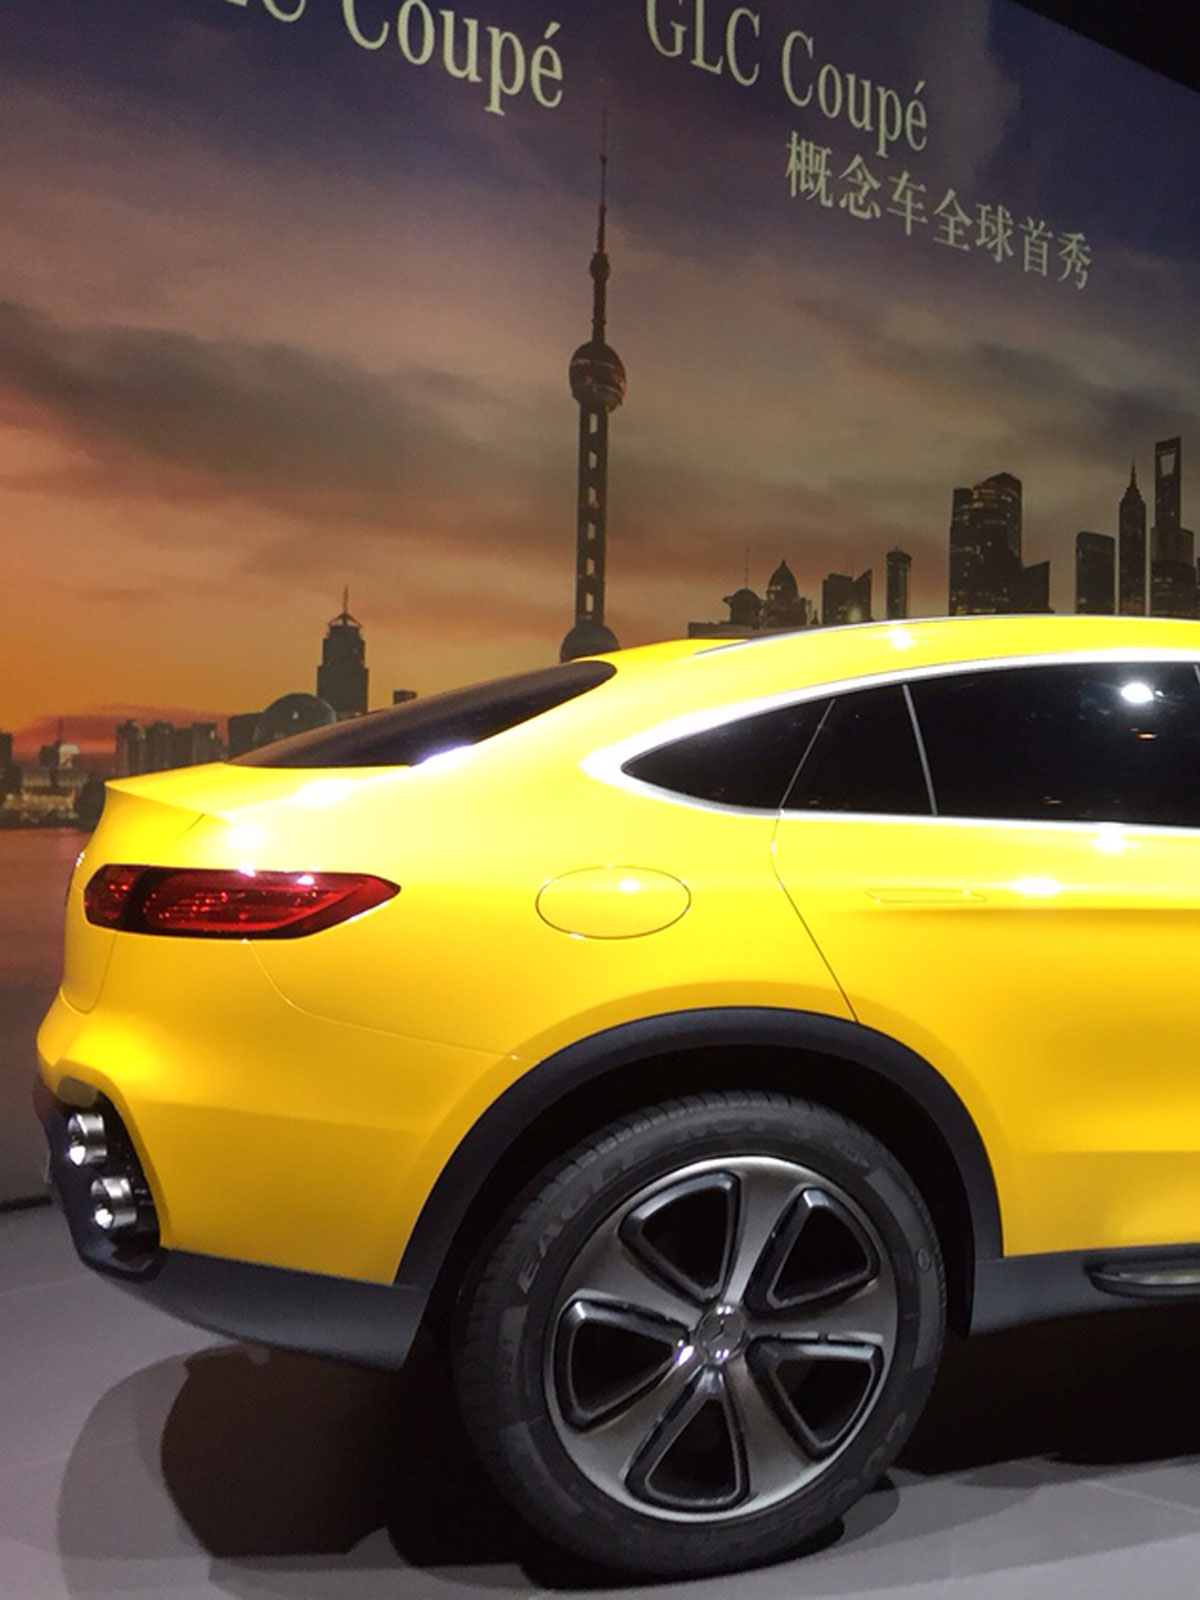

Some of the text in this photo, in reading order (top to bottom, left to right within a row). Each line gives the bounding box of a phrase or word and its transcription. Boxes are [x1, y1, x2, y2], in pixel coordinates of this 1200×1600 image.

[646, 0, 928, 158] GLC Coupé
[784, 130, 1093, 291] 概念车全球首秀
